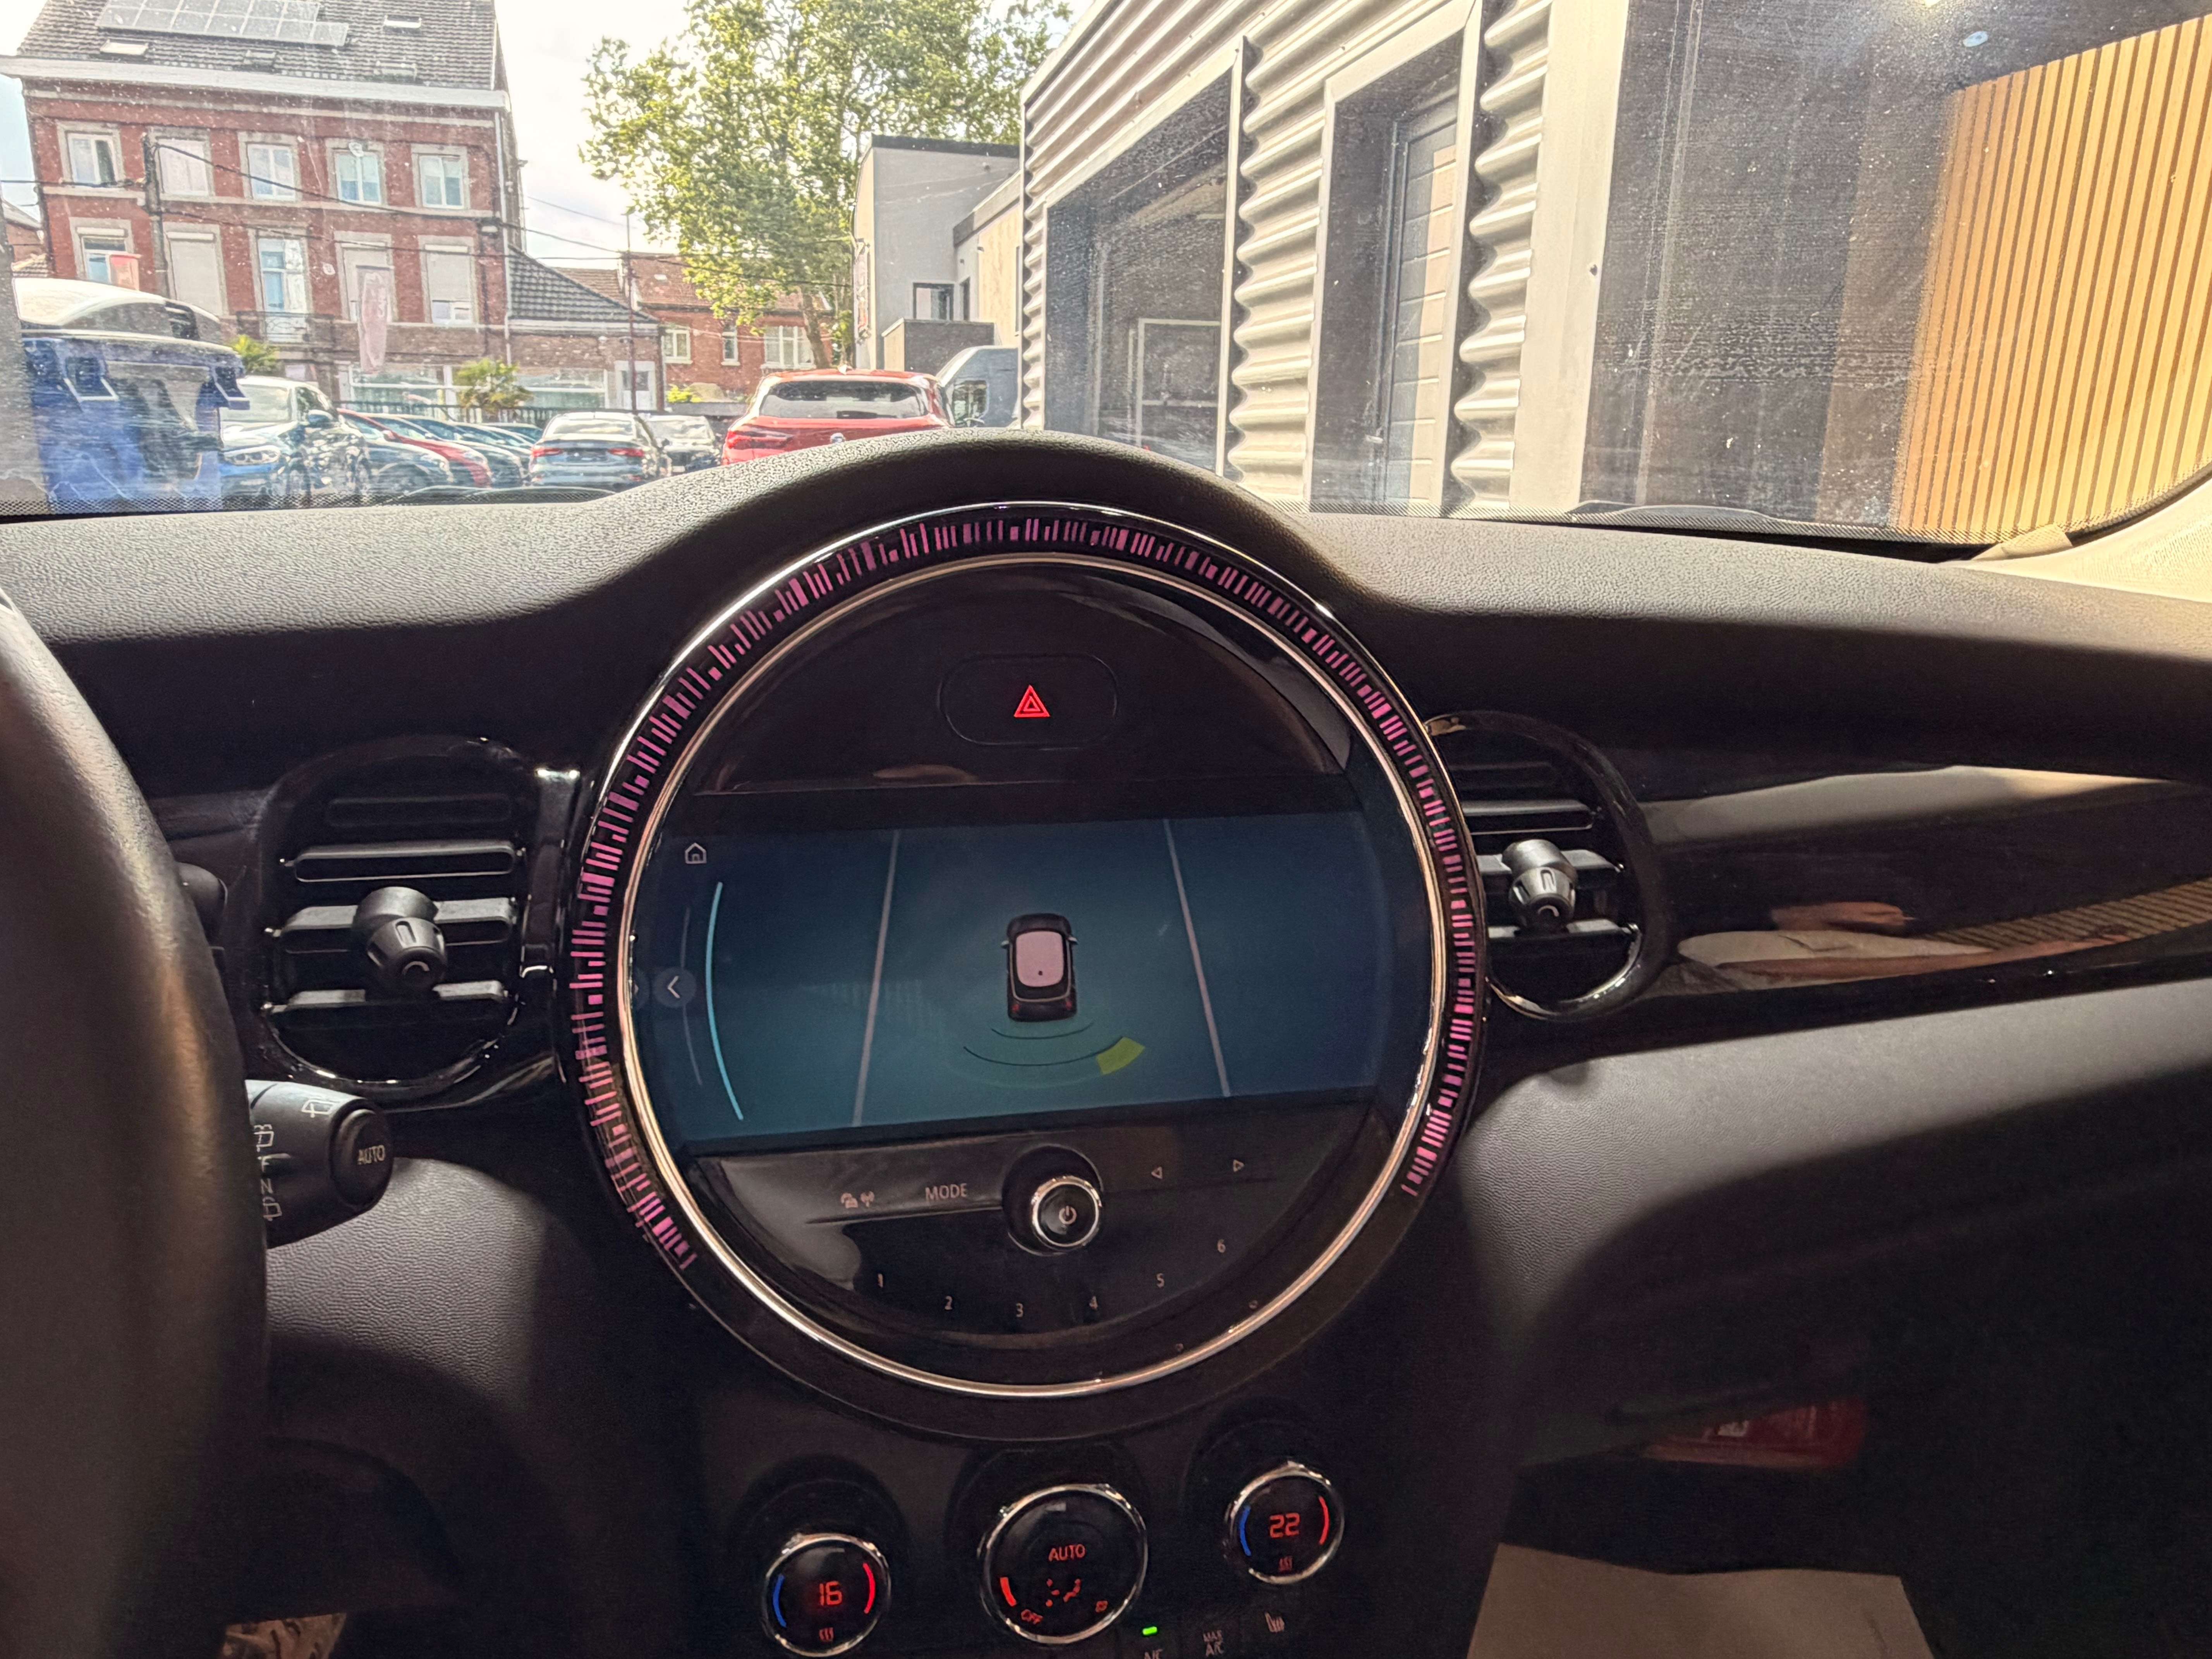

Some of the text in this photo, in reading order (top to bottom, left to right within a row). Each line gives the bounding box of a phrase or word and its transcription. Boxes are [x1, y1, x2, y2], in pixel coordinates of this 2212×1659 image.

[357, 1144, 386, 1165] AUTO
[925, 1183, 967, 1201] MODE
[1217, 1239, 1226, 1253] 6
[878, 1273, 884, 1288] 1
[1156, 1273, 1164, 1288] 5
[945, 1295, 953, 1310] 2
[1016, 1302, 1024, 1317] 3
[1089, 1295, 1098, 1310] 4
[1270, 1513, 1300, 1538] 22
[1048, 1544, 1085, 1561] AUTO
[819, 1581, 842, 1606] 16
